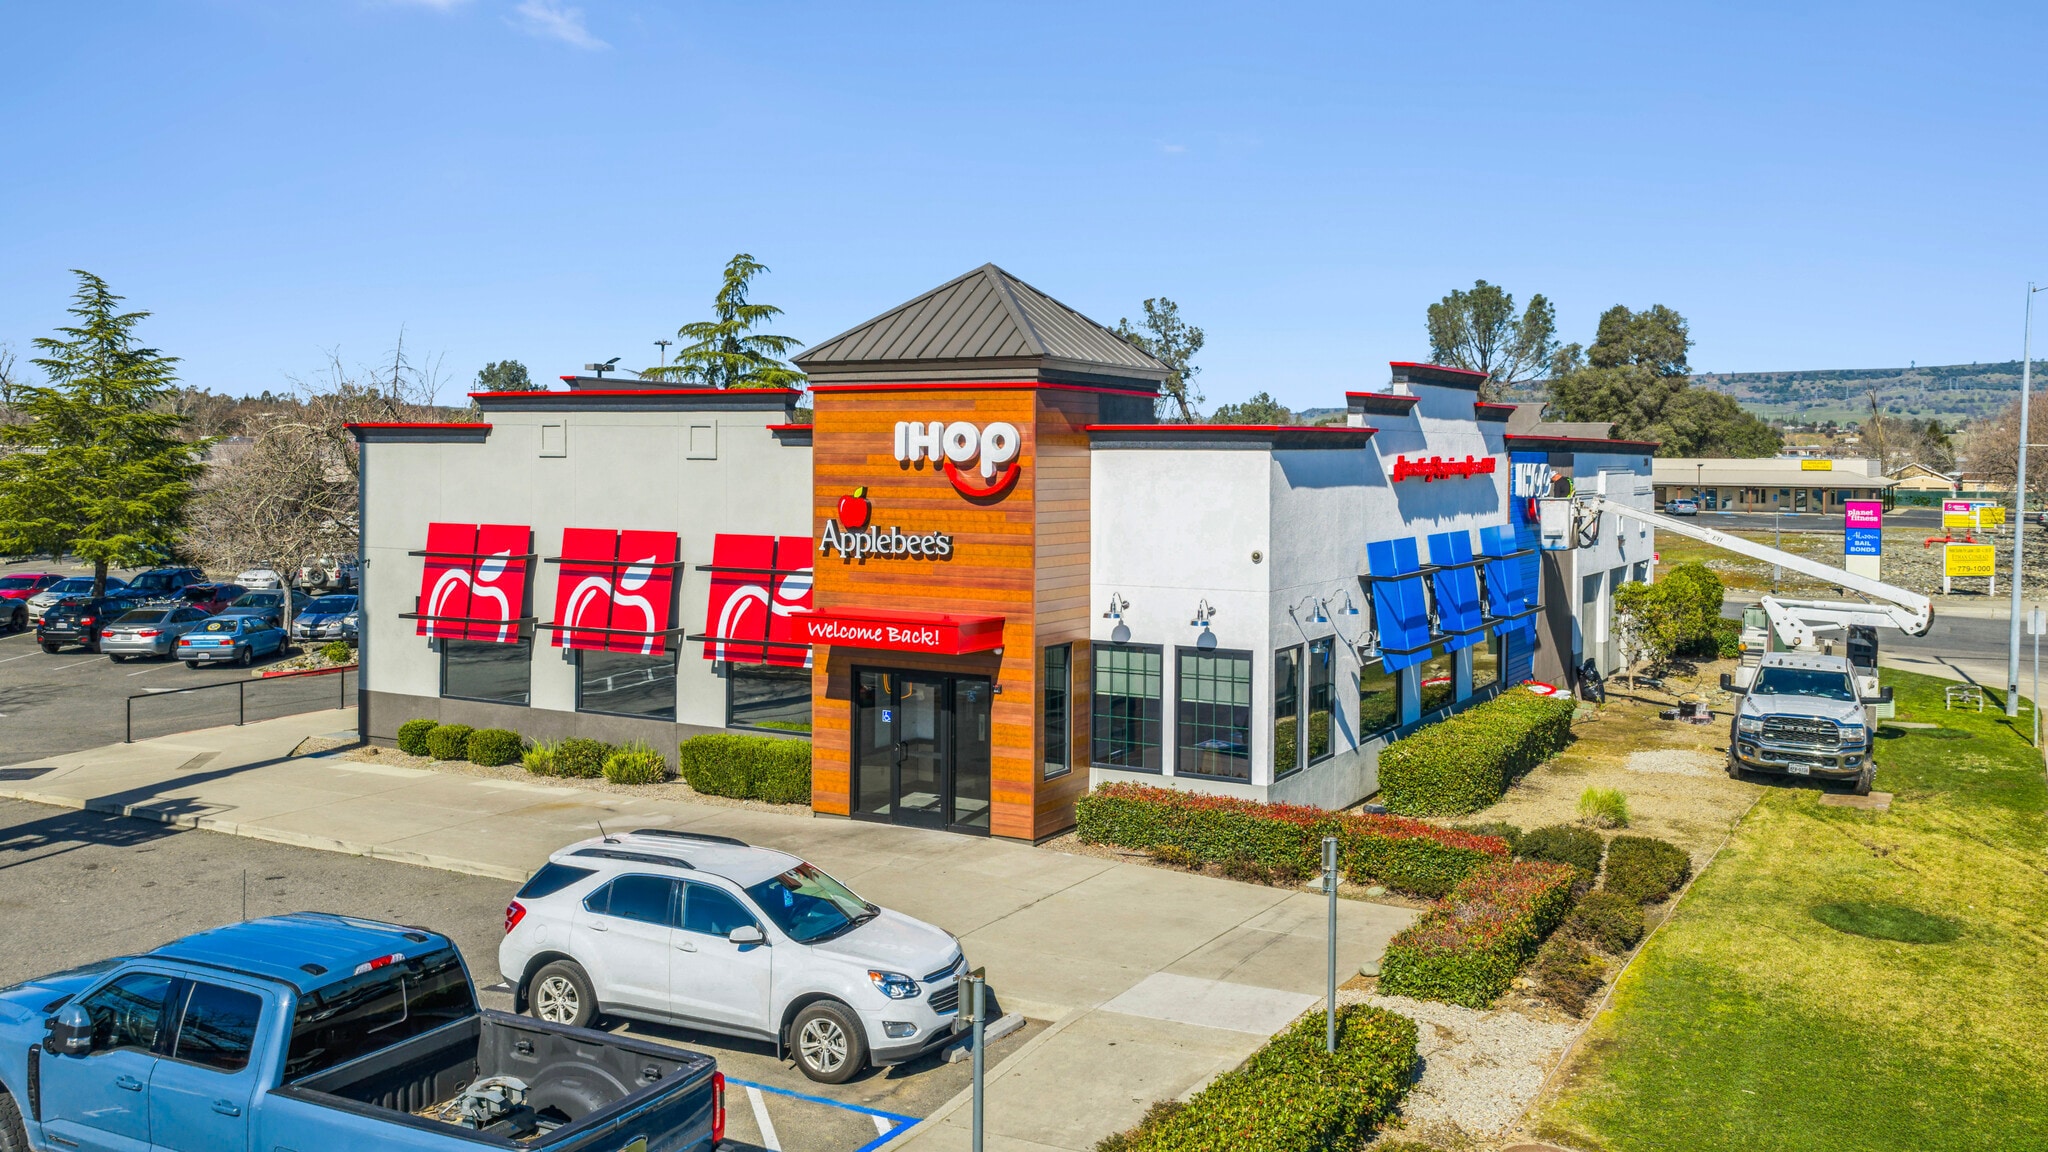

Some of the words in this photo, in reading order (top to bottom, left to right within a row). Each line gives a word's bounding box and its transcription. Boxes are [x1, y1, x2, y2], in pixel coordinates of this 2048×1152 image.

[894, 421, 1021, 478] IHOP
[1847, 509, 1874, 517] planet
[1851, 514, 1879, 522] fitness
[818, 519, 951, 559] Applebee's
[807, 621, 883, 643] Welcome
[886, 627, 940, 646] Back!
